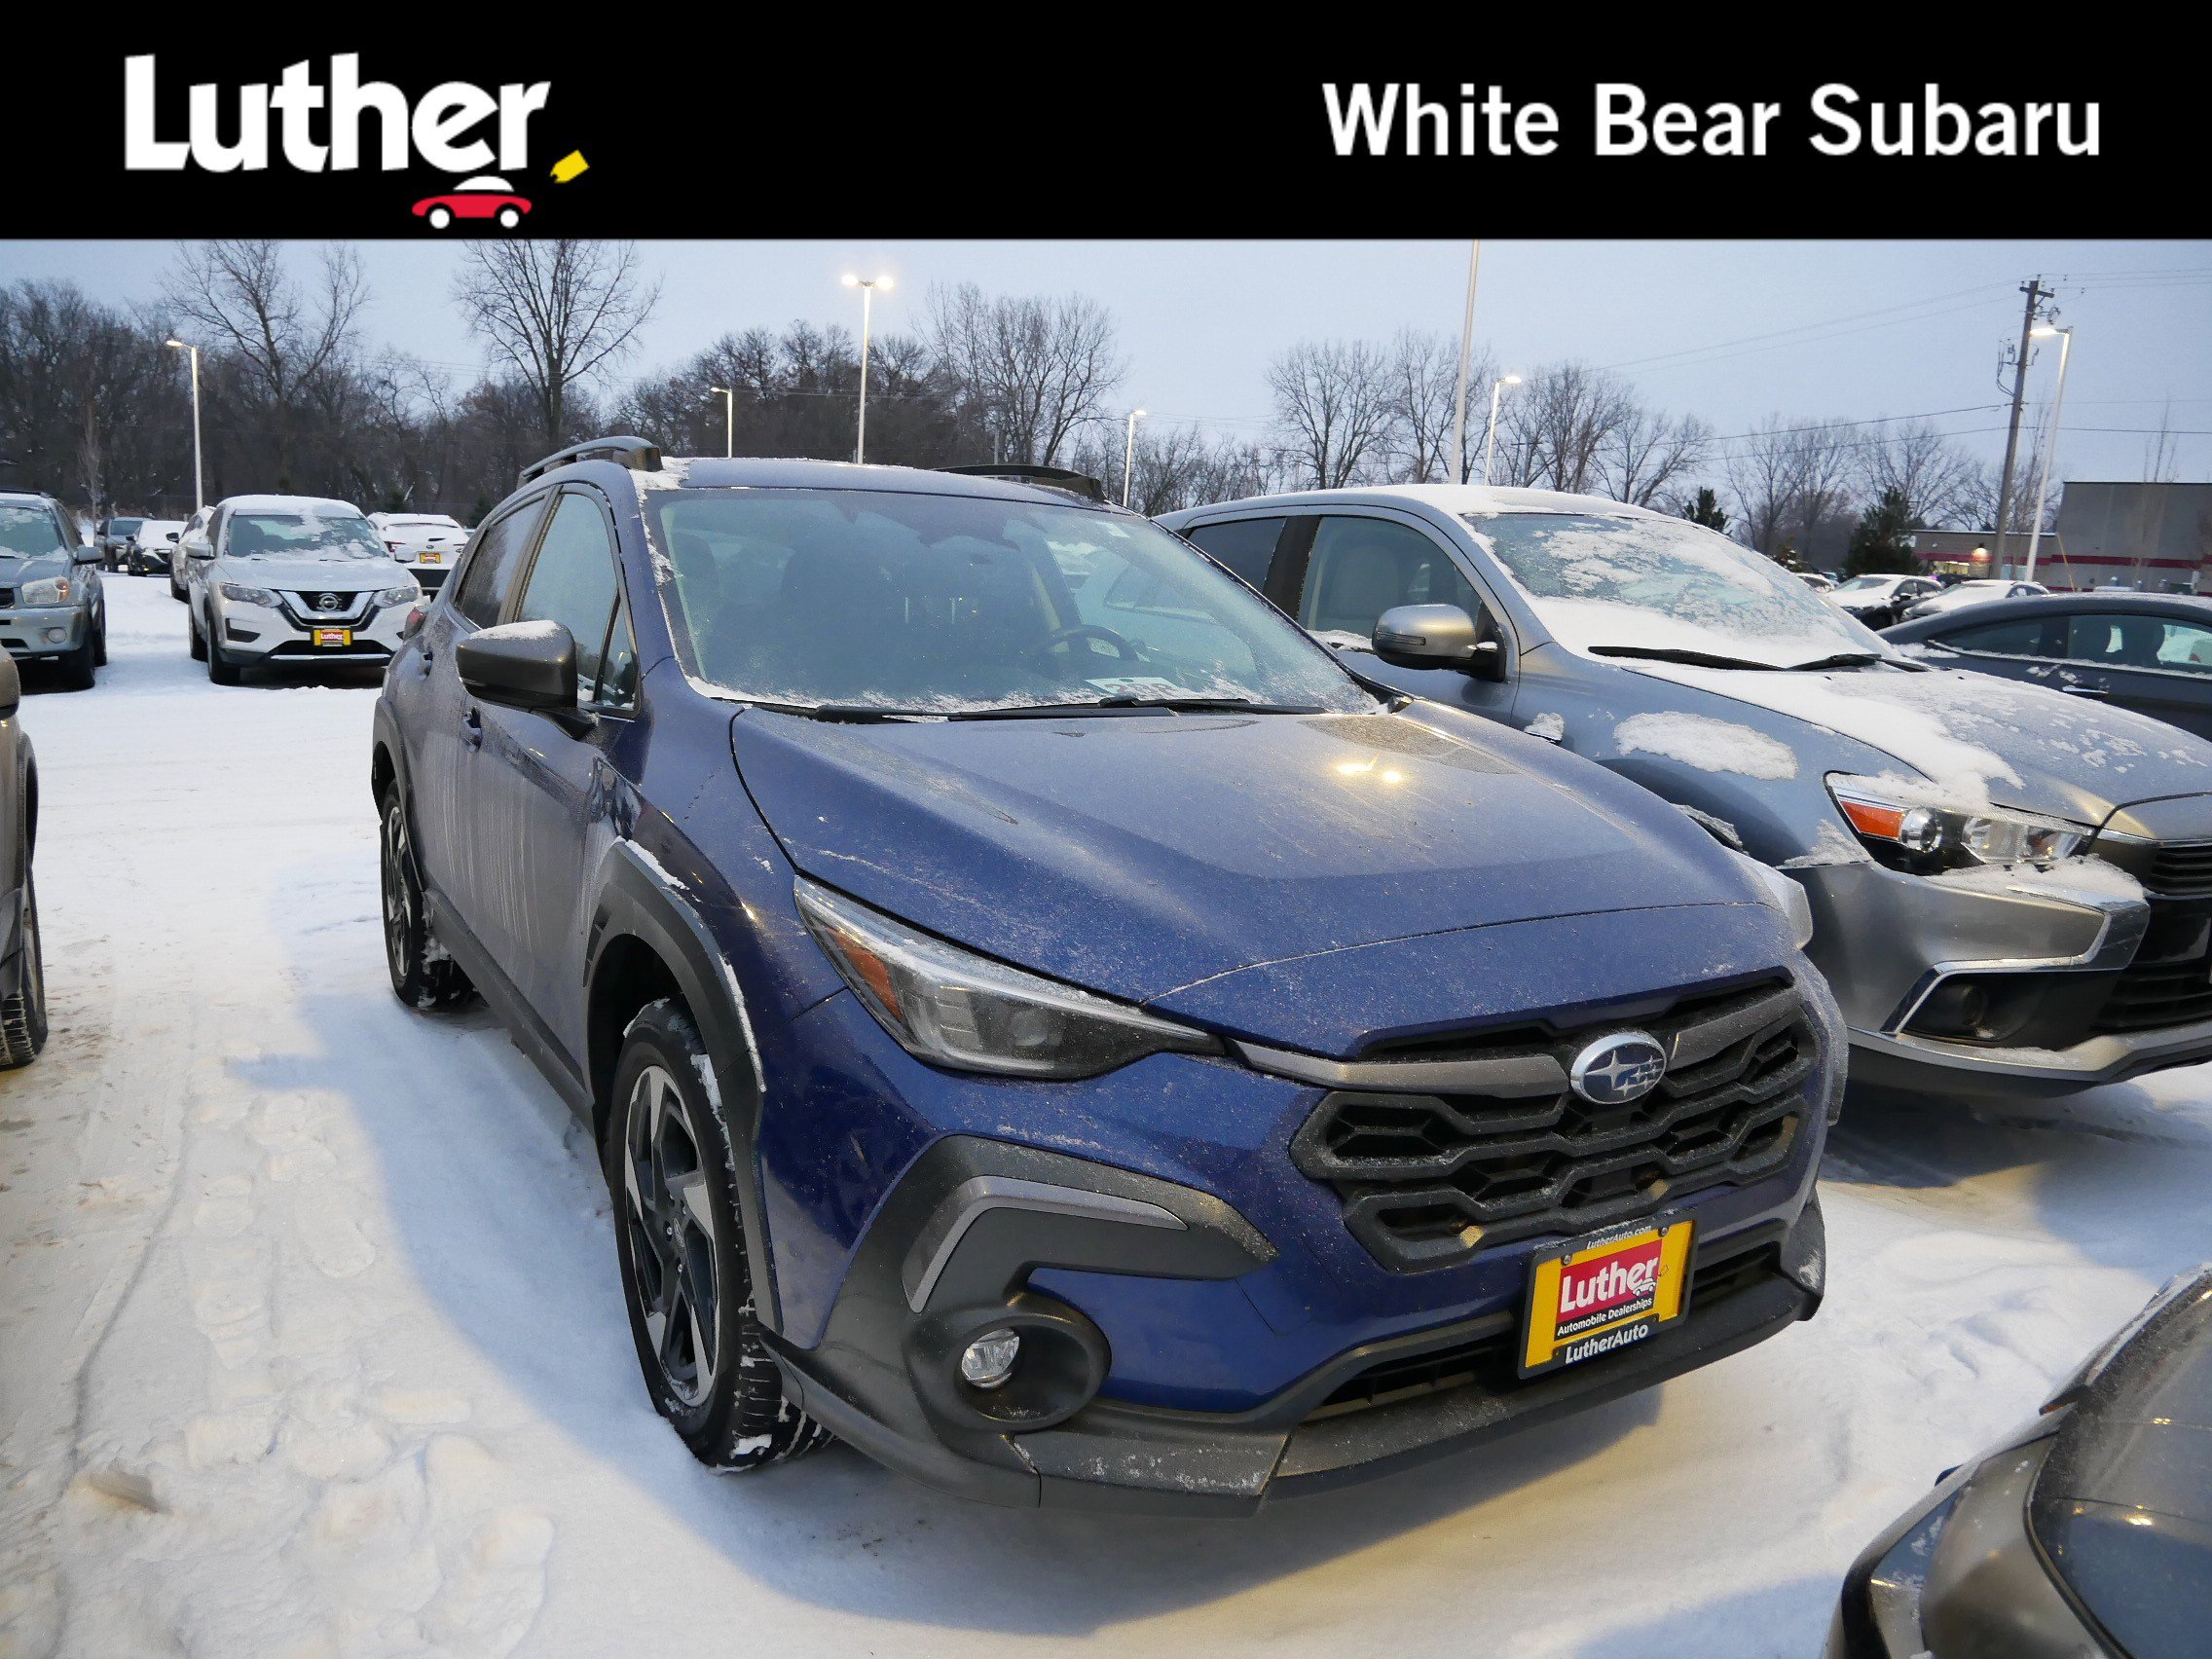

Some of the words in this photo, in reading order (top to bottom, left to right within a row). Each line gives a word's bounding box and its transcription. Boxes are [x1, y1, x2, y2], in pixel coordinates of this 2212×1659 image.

[1586, 1225, 1652, 1250] LutherAuto.com
[1560, 1256, 1659, 1313] Luther
[1557, 1312, 1607, 1337] Automobile
[1607, 1297, 1653, 1320] Dealerships
[1565, 1323, 1649, 1365] LutherAuto
